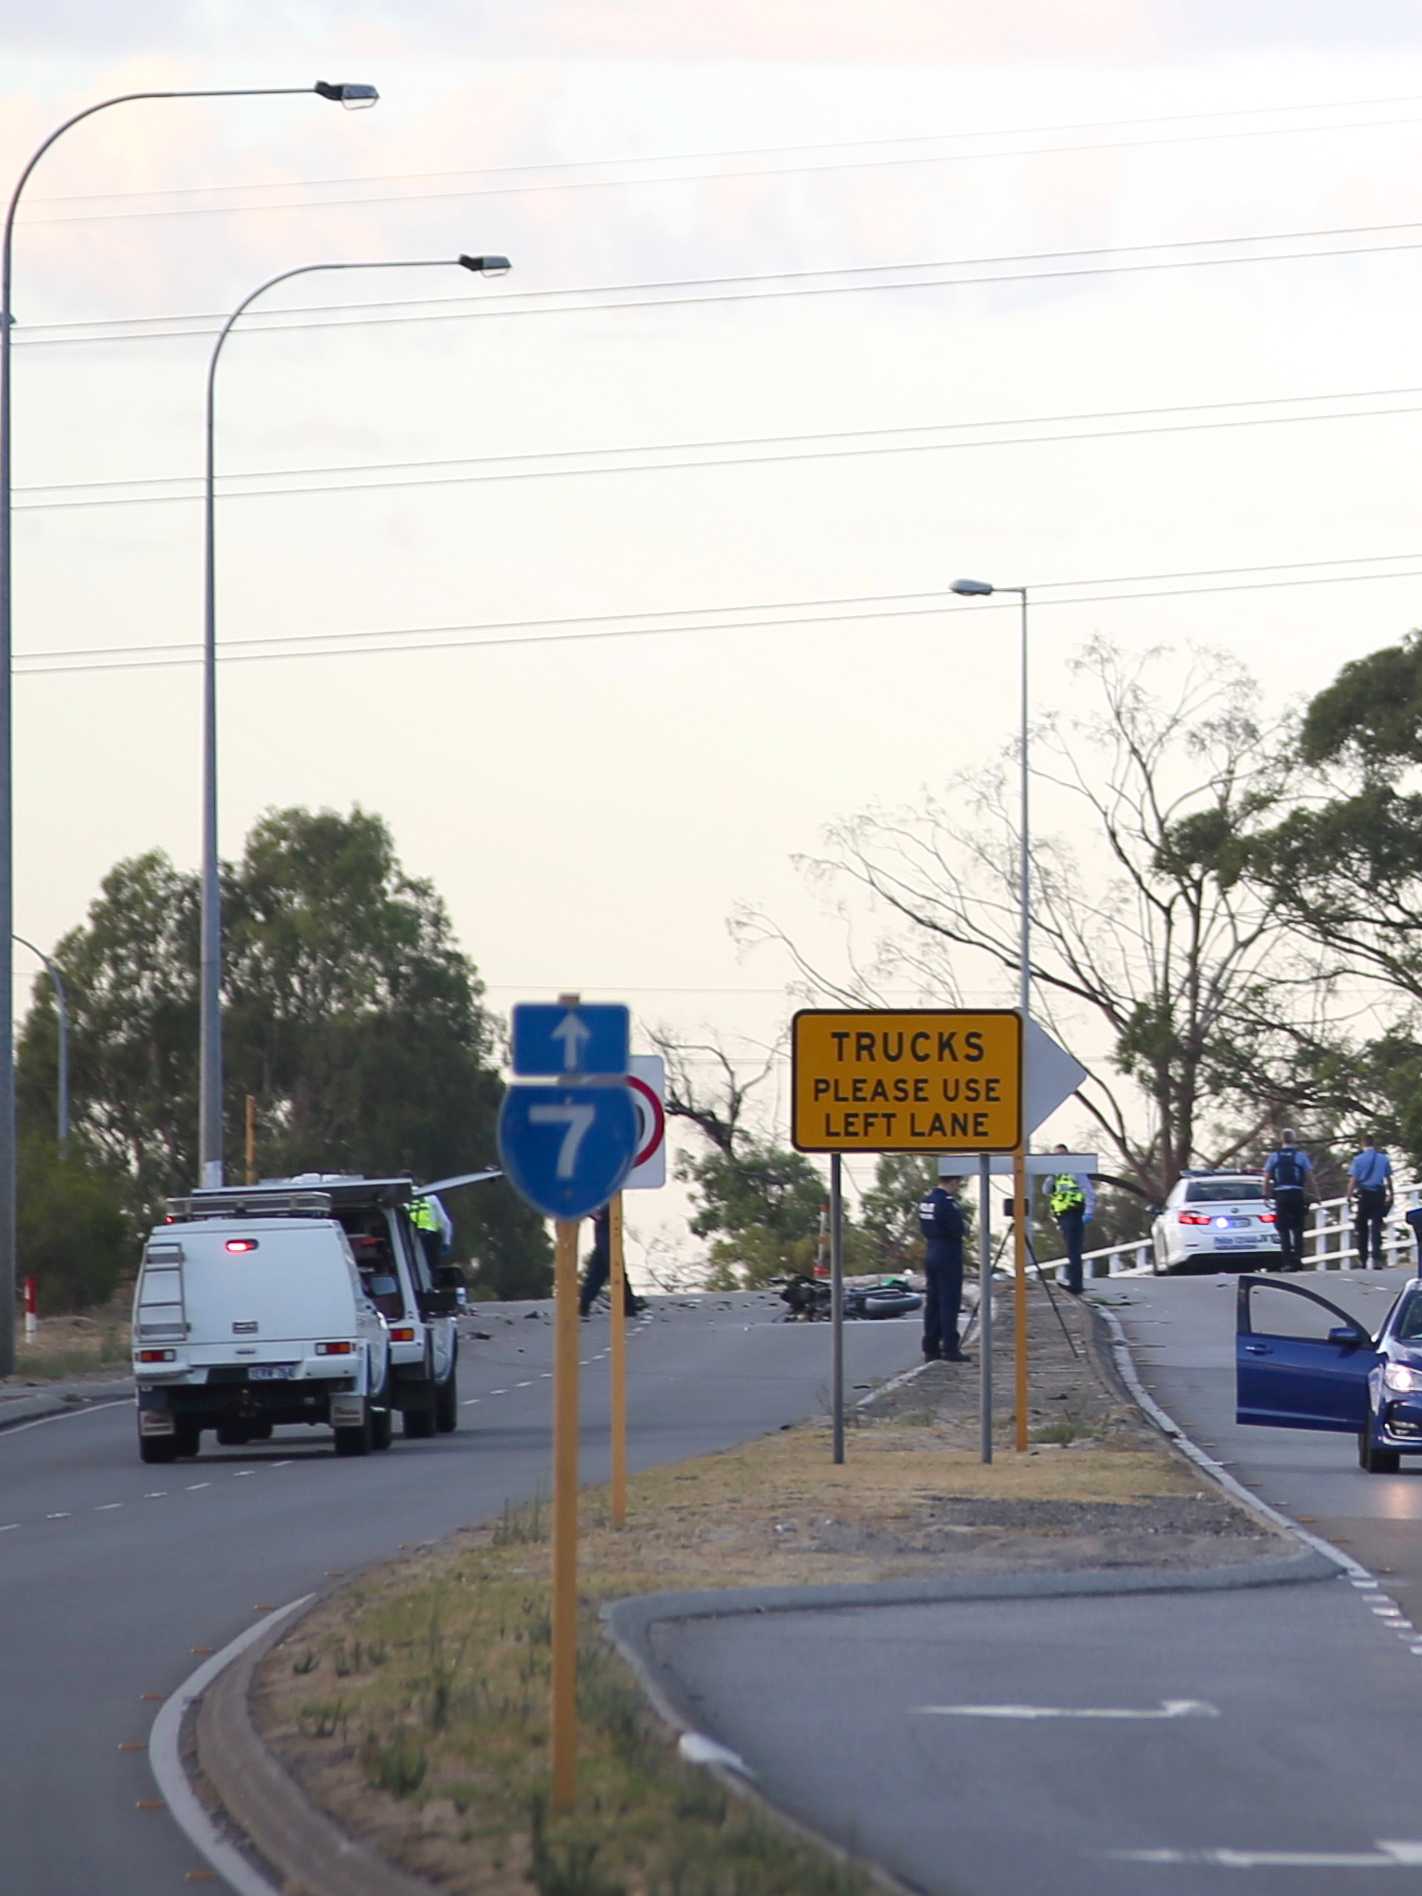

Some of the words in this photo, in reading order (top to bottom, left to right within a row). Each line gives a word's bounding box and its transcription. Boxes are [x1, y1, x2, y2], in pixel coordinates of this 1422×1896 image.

[830, 1031, 985, 1062] TRUCKS
[813, 1078, 929, 1102] PLEASE
[943, 1078, 1001, 1102] USE
[825, 1113, 897, 1137] LEFT
[910, 1113, 989, 1137] LANE
[528, 1103, 596, 1179] 7
